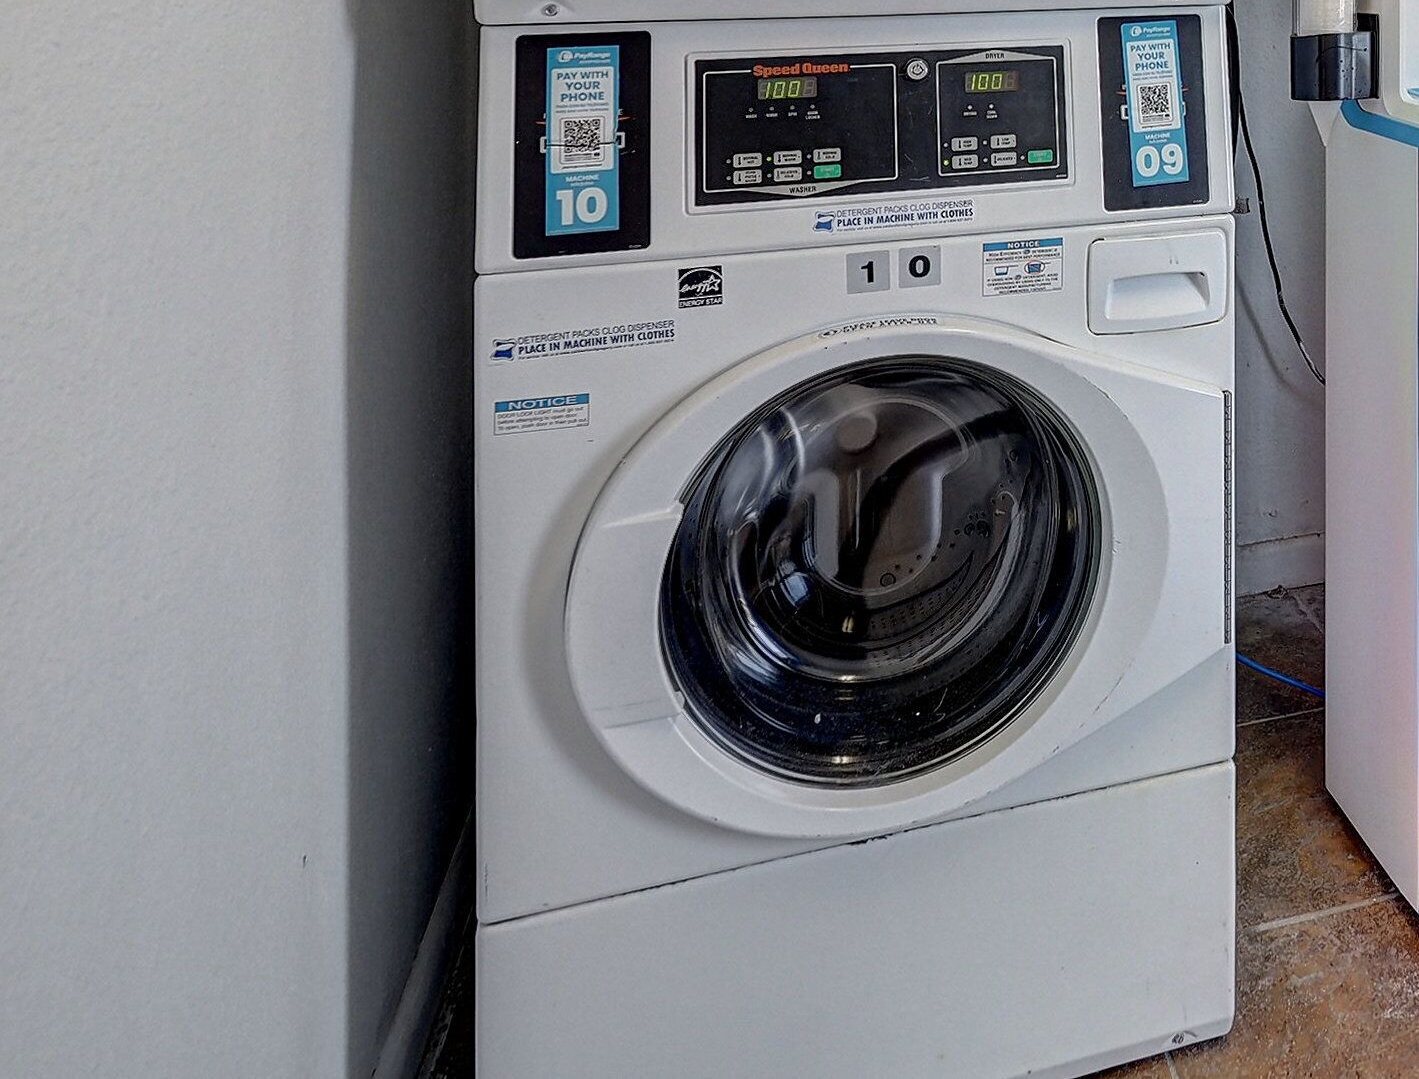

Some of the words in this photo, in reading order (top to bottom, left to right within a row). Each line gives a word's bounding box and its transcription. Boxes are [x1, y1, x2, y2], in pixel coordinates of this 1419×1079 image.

[1130, 44, 1146, 52] PAY
[1148, 42, 1171, 50] WITH
[1137, 52, 1165, 61] YOUR
[753, 63, 800, 77] Speed
[801, 62, 849, 74] Queen
[1135, 61, 1169, 71] PHONE
[556, 72, 578, 80] PAY
[580, 71, 609, 79] WITH
[565, 81, 600, 90] YOUR
[560, 91, 605, 101] PHONE
[1136, 143, 1183, 177] 09
[789, 185, 817, 194] WASHER
[556, 187, 608, 226] 10
[837, 209, 883, 218] DETERGENT
[884, 205, 909, 214] PACKS
[910, 203, 931, 211] CLOG
[932, 200, 973, 210] DISPENSER
[837, 217, 861, 226] PLACE
[863, 216, 873, 224] IN
[876, 213, 914, 223] MACHINE
[916, 211, 938, 220] WITH
[940, 209, 973, 219] CLOTHES
[1007, 241, 1040, 249] NOTICE
[860, 260, 874, 283] 1
[908, 255, 931, 278] 0
[680, 299, 705, 307] ENERGY
[706, 297, 722, 305] STAR
[518, 332, 570, 345] DETERGENT
[572, 329, 600, 339] PACKS
[602, 325, 627, 336] CLOG
[628, 320, 675, 332] DISPENSER
[519, 343, 546, 355] PLACE
[549, 342, 560, 351] IN
[563, 336, 608, 350] MACHINE
[610, 333, 635, 344] WITH
[637, 329, 674, 341] CLOTHES
[508, 396, 577, 410] NOTICE
